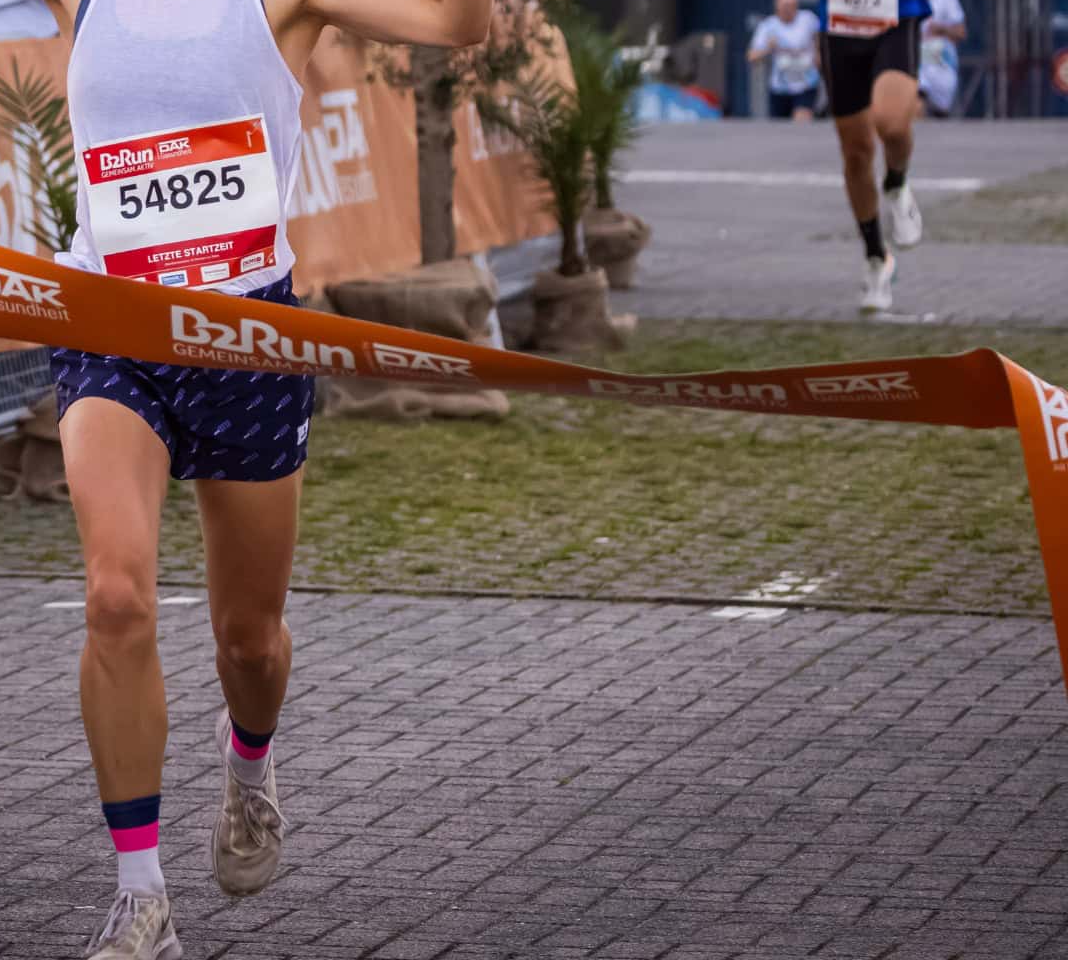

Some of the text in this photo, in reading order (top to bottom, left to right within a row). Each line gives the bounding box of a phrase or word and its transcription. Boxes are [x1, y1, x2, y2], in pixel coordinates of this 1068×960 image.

[157, 137, 190, 153] DAK
[99, 148, 154, 171] B2Run
[119, 164, 245, 220] 54825
[147, 247, 182, 264] LETZTE
[183, 241, 234, 257] STARTZEIT
[170, 304, 356, 370] B2Run
[373, 342, 475, 378] DAK
[804, 371, 915, 394] DAK
